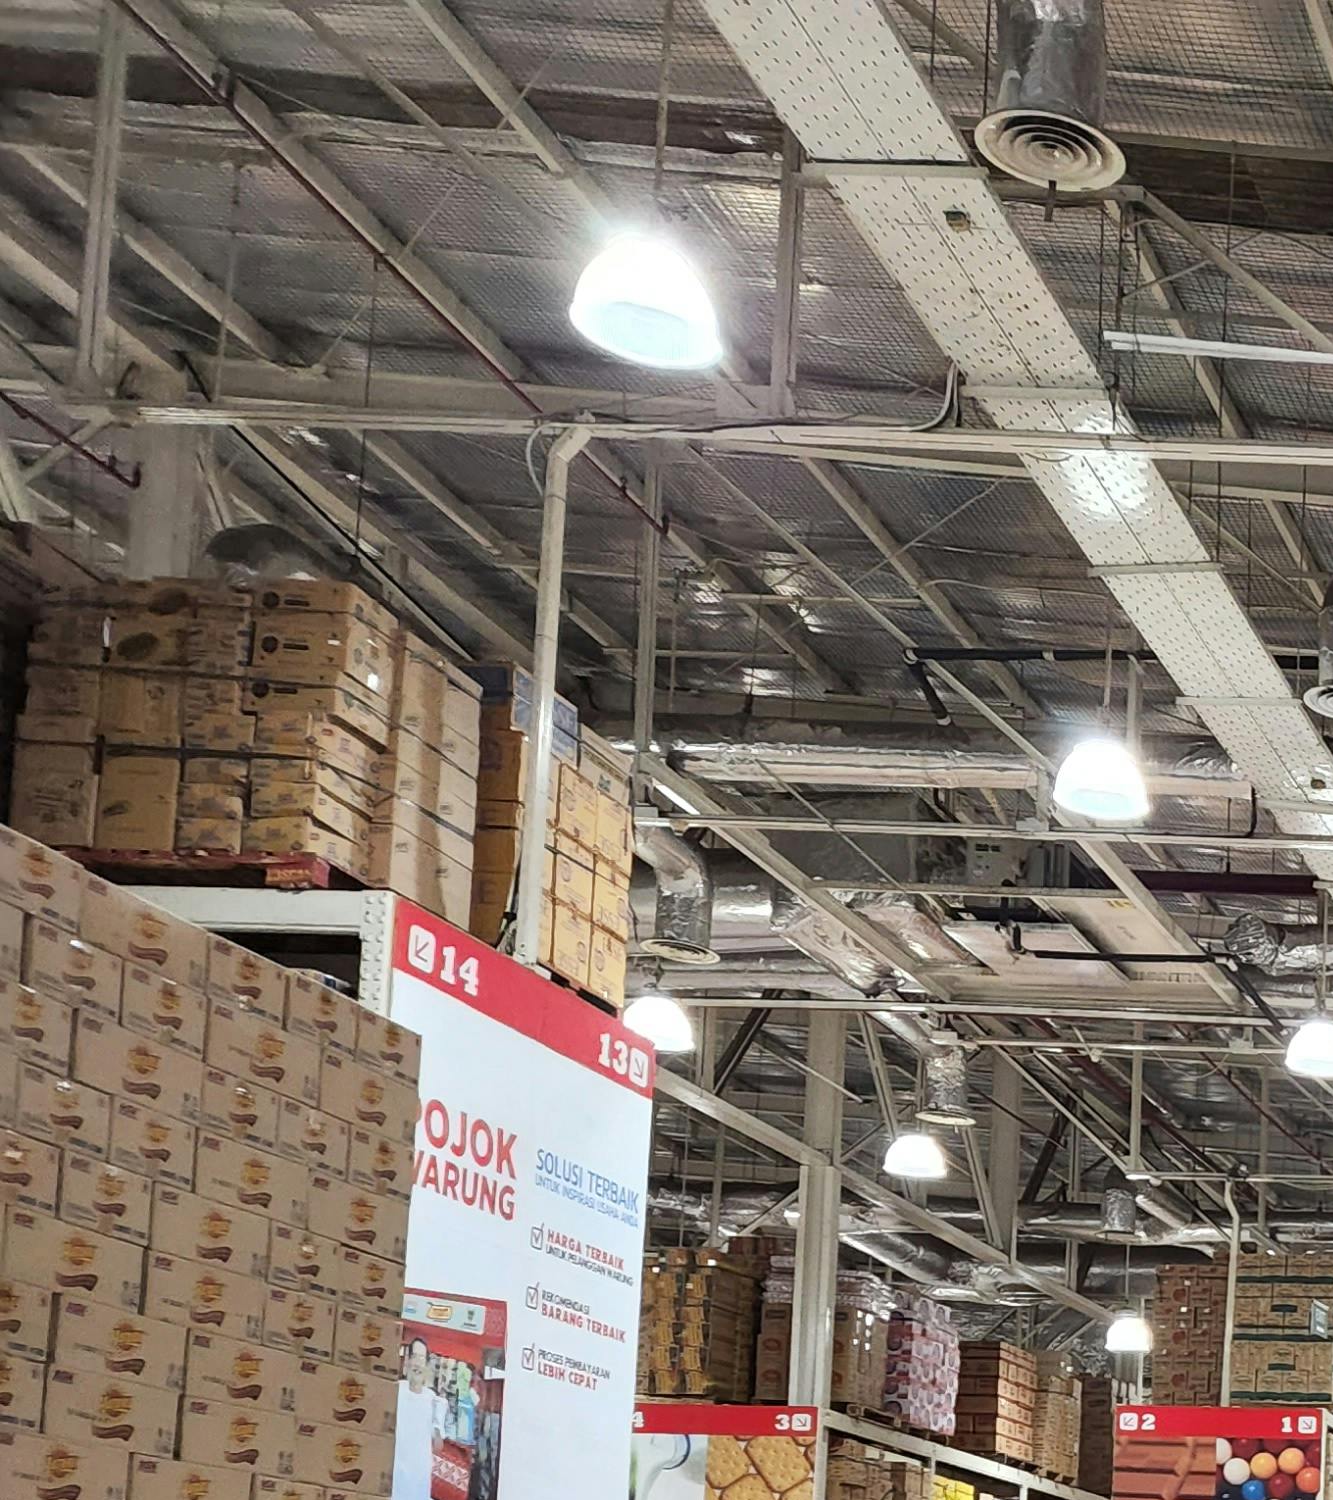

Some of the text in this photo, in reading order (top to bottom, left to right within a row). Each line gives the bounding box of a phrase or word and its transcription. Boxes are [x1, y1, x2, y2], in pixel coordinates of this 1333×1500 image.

[440, 945, 479, 997] 14
[599, 1033, 628, 1076] 13
[415, 1099, 517, 1181] OJOK
[536, 1148, 640, 1214] SOLUSI TERBAIK
[547, 1228, 625, 1271] HARGA TERBAIK
[542, 1303, 626, 1343] BARANG TERBAIK
[537, 1361, 598, 1391] LEBIH CEPAT
[633, 1411, 644, 1428] 4
[775, 1414, 790, 1430] 3
[1141, 1415, 1156, 1430] 2
[1281, 1416, 1293, 1432] 1
